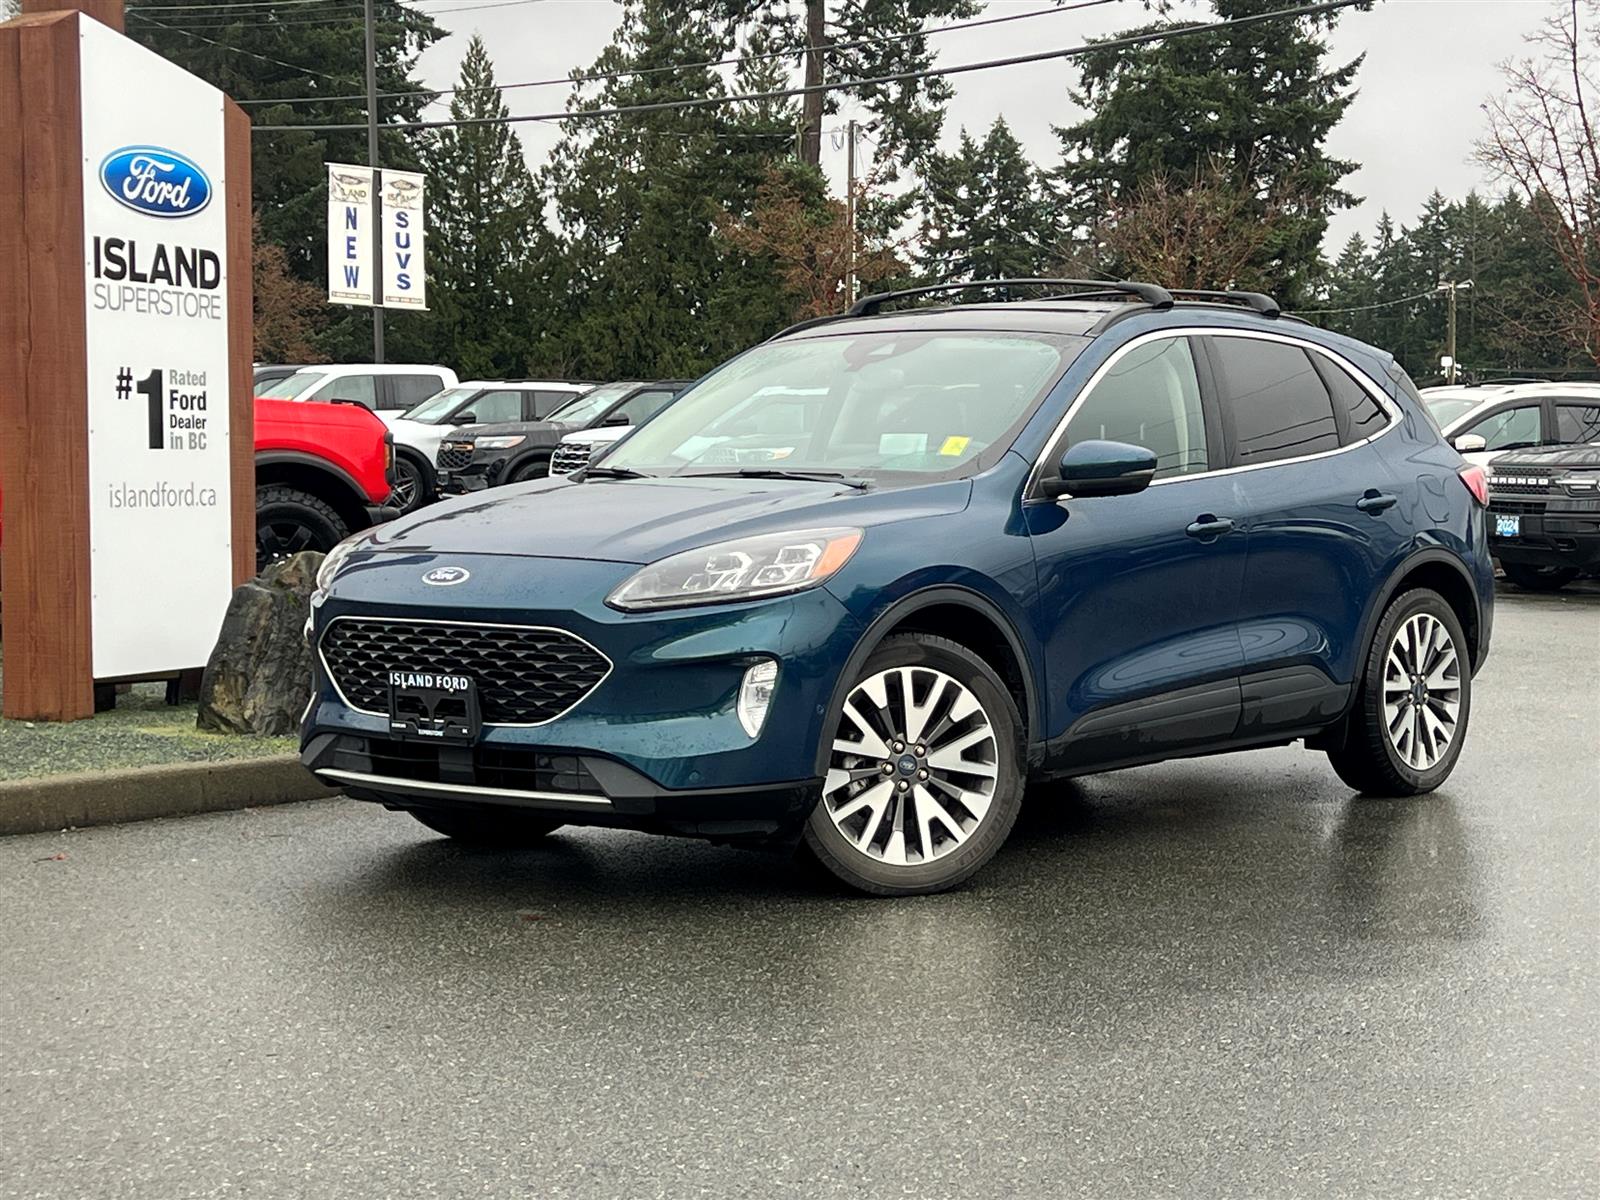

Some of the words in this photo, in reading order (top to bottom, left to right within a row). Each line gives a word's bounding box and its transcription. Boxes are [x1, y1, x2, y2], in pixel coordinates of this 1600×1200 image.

[123, 156, 191, 208] Ford
[344, 206, 360, 289] NEW
[395, 211, 411, 290] SUVS
[93, 236, 221, 290] ISLAND
[94, 283, 221, 319] SUPERSTORE
[169, 369, 207, 386] Rated
[169, 389, 207, 411] Ford
[169, 413, 207, 429] Dealer
[170, 431, 183, 450] in
[188, 432, 207, 450] BC
[109, 481, 216, 508] islandford.ca
[389, 672, 433, 688] ISLAND
[436, 675, 469, 690] FORD
